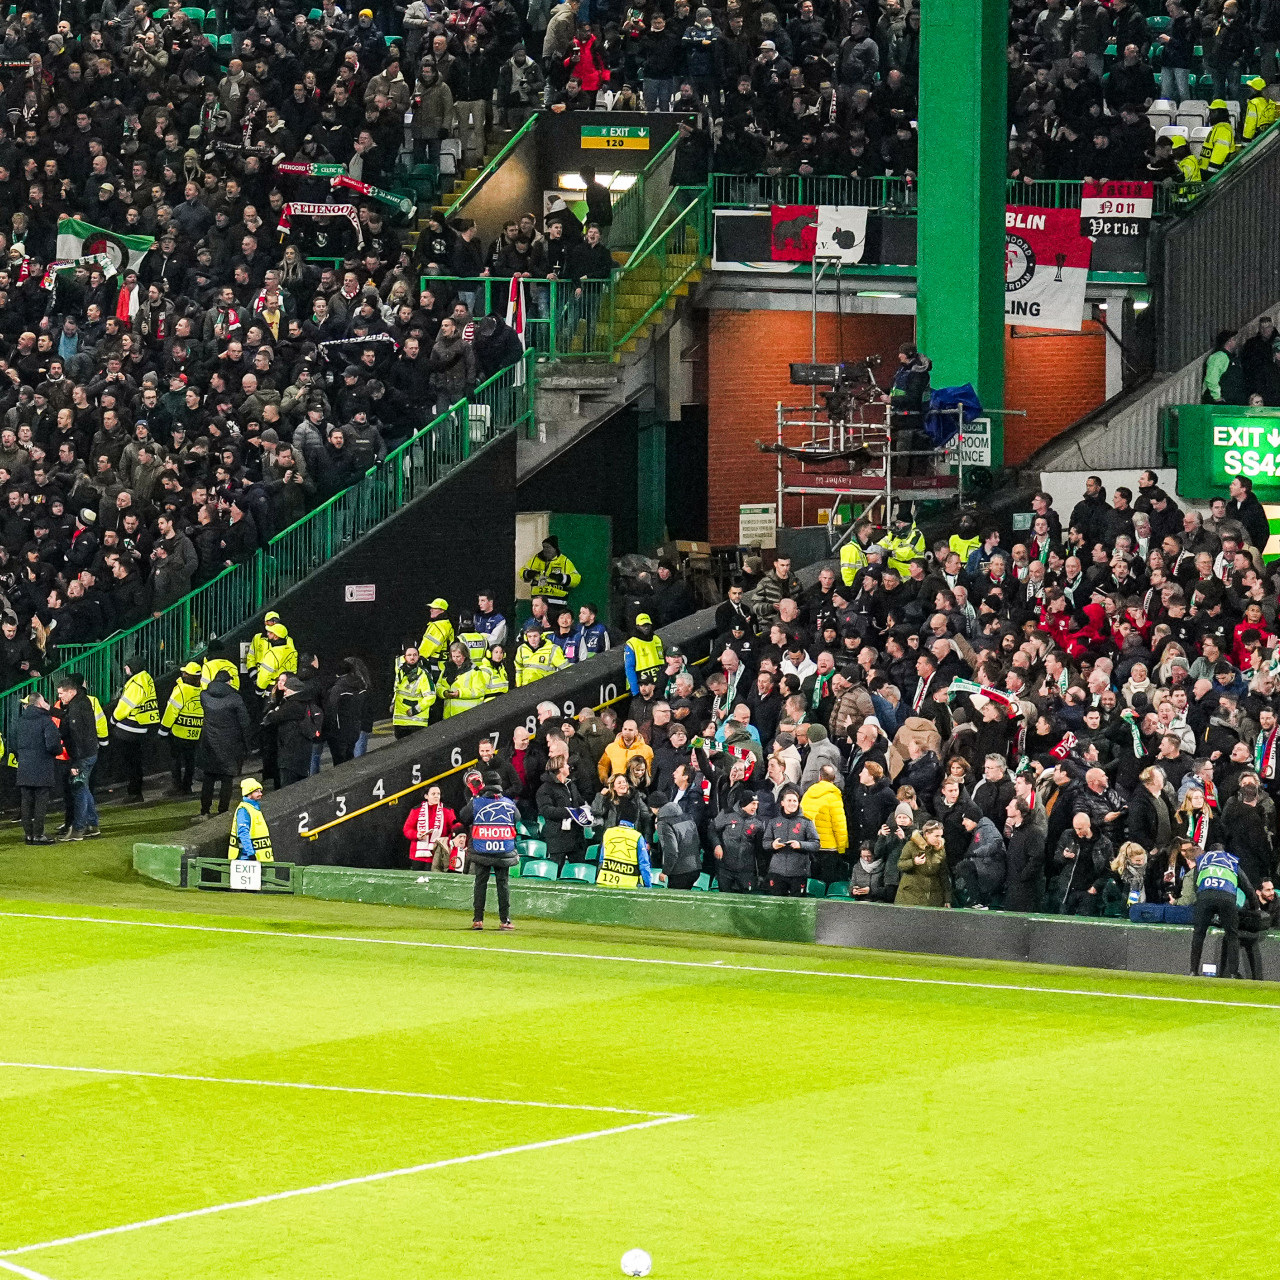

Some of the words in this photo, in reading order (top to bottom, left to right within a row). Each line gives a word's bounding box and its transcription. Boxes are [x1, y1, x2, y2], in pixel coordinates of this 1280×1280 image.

[610, 127, 630, 136] EXIT
[606, 139, 625, 148] 120
[1097, 200, 1136, 215] Non
[1089, 218, 1140, 235] Verba
[962, 436, 989, 449] ROOM
[1213, 426, 1265, 448] EXIT
[600, 683, 618, 705] 10
[563, 700, 575, 719] 9
[526, 715, 537, 735] 8
[187, 729, 199, 738] 388
[490, 731, 500, 752] 7
[451, 747, 462, 768] 6
[411, 764, 422, 785] 5
[372, 778, 385, 800] 4
[336, 795, 347, 817] 3
[298, 811, 309, 833] 2
[478, 827, 511, 838] PHOTO
[486, 841, 506, 850] 001
[235, 864, 256, 874] EXIT
[1208, 866, 1225, 877] TV
[240, 876, 252, 885] S1
[603, 873, 620, 885] 129
[1204, 877, 1226, 889] 057
